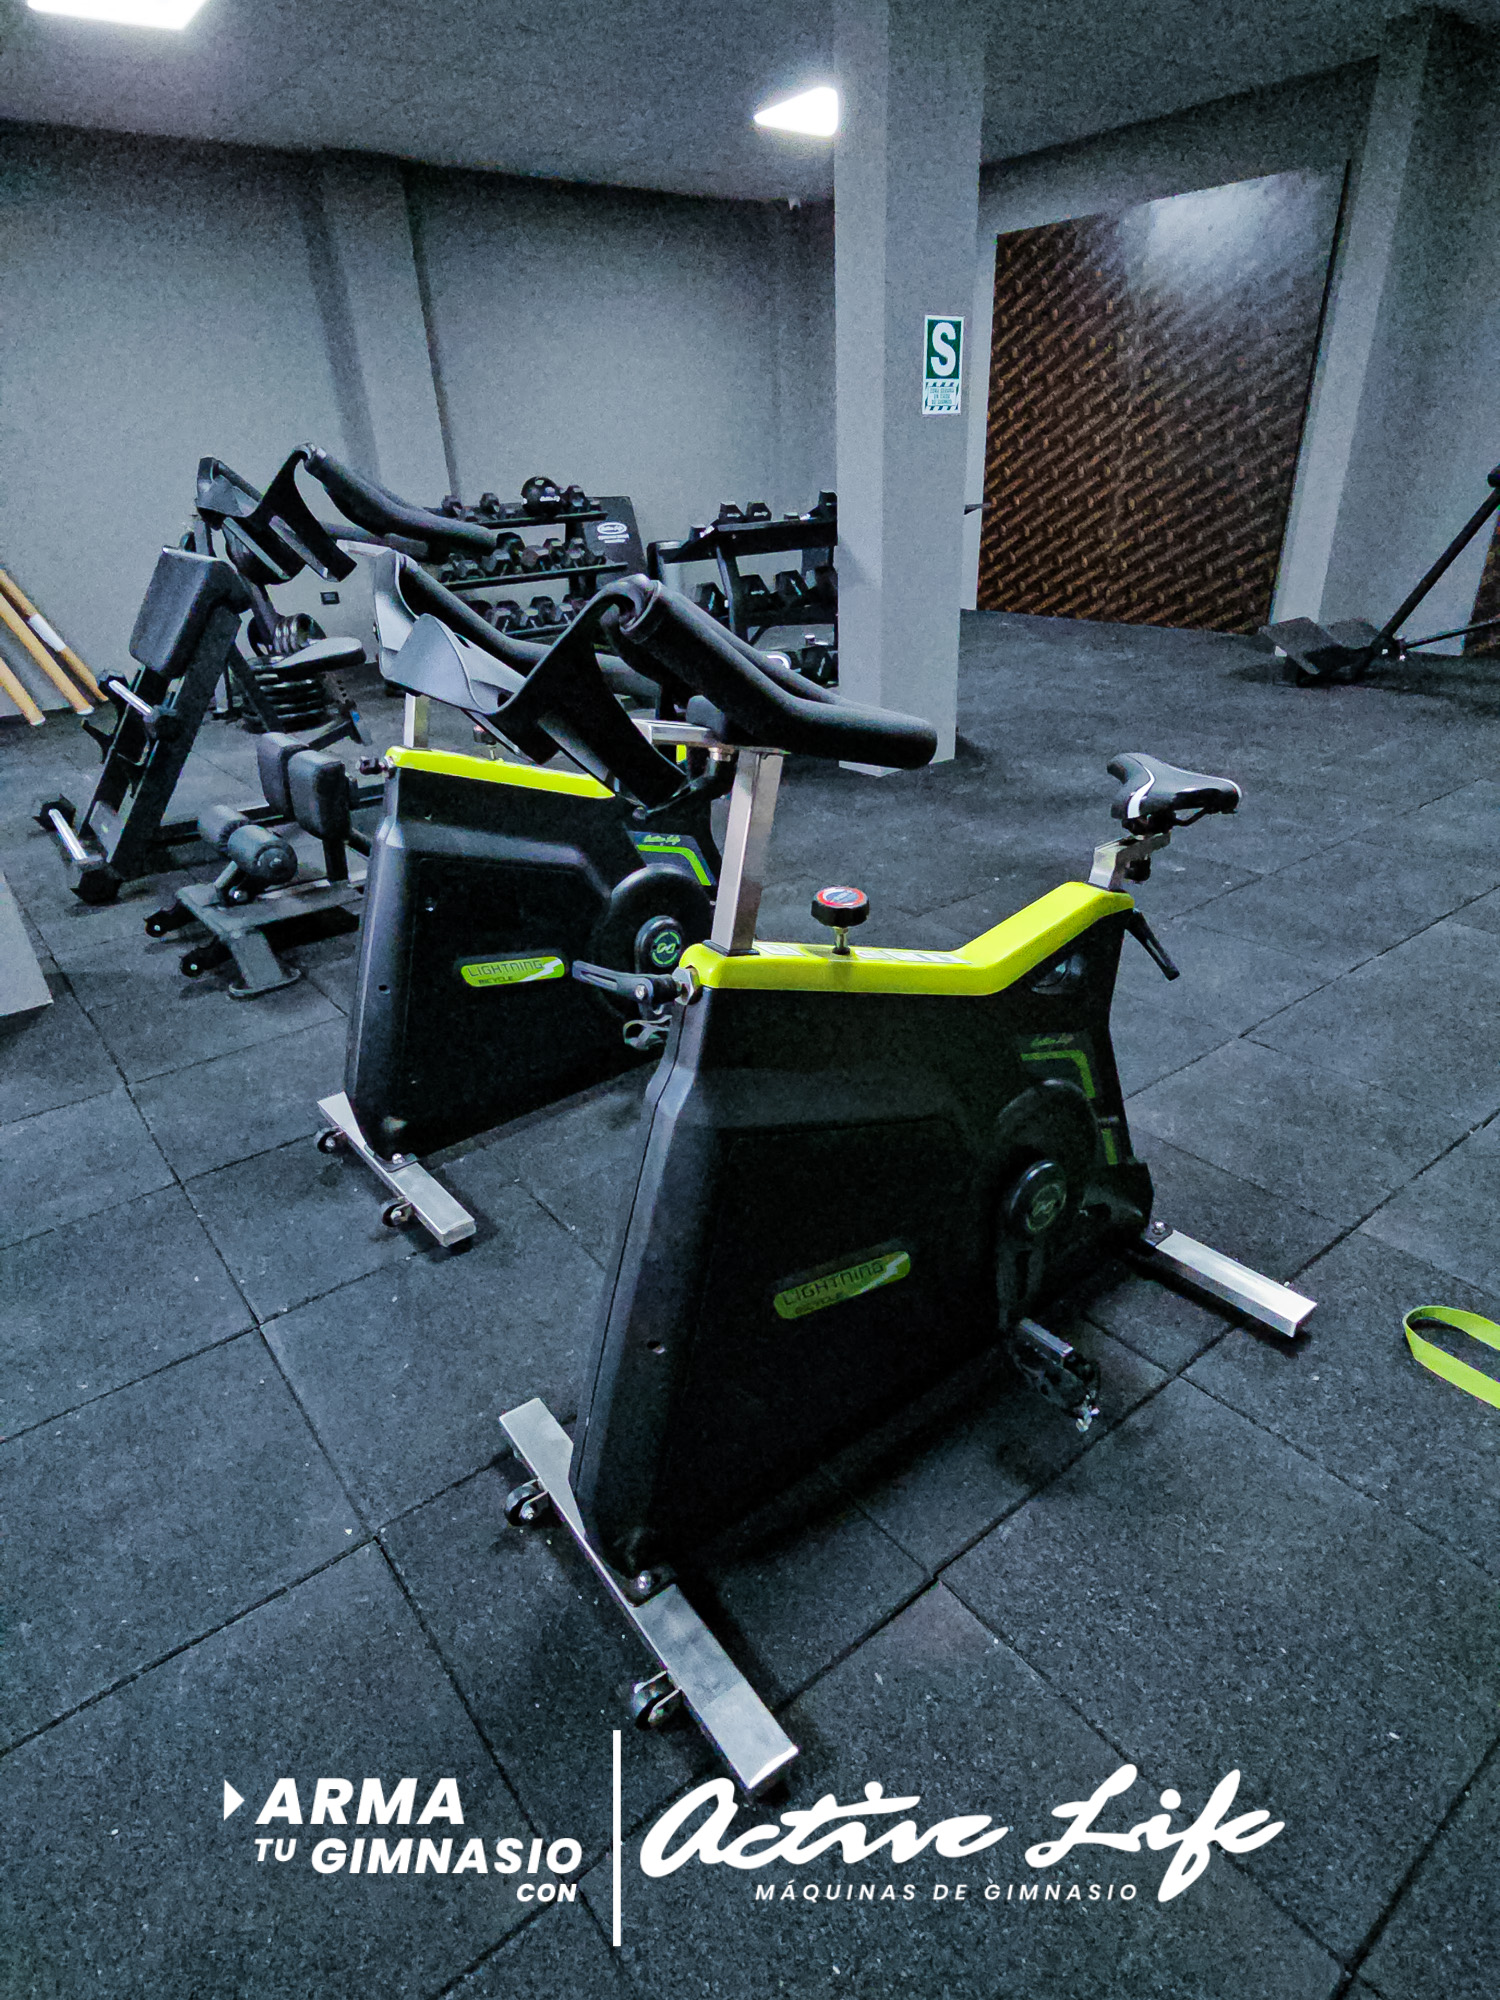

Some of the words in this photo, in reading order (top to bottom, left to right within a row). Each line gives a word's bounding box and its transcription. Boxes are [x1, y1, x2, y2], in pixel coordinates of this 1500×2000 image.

[931, 321, 956, 377] S
[467, 959, 545, 977] LIGHTNING
[781, 1259, 885, 1306] LIGHTNING
